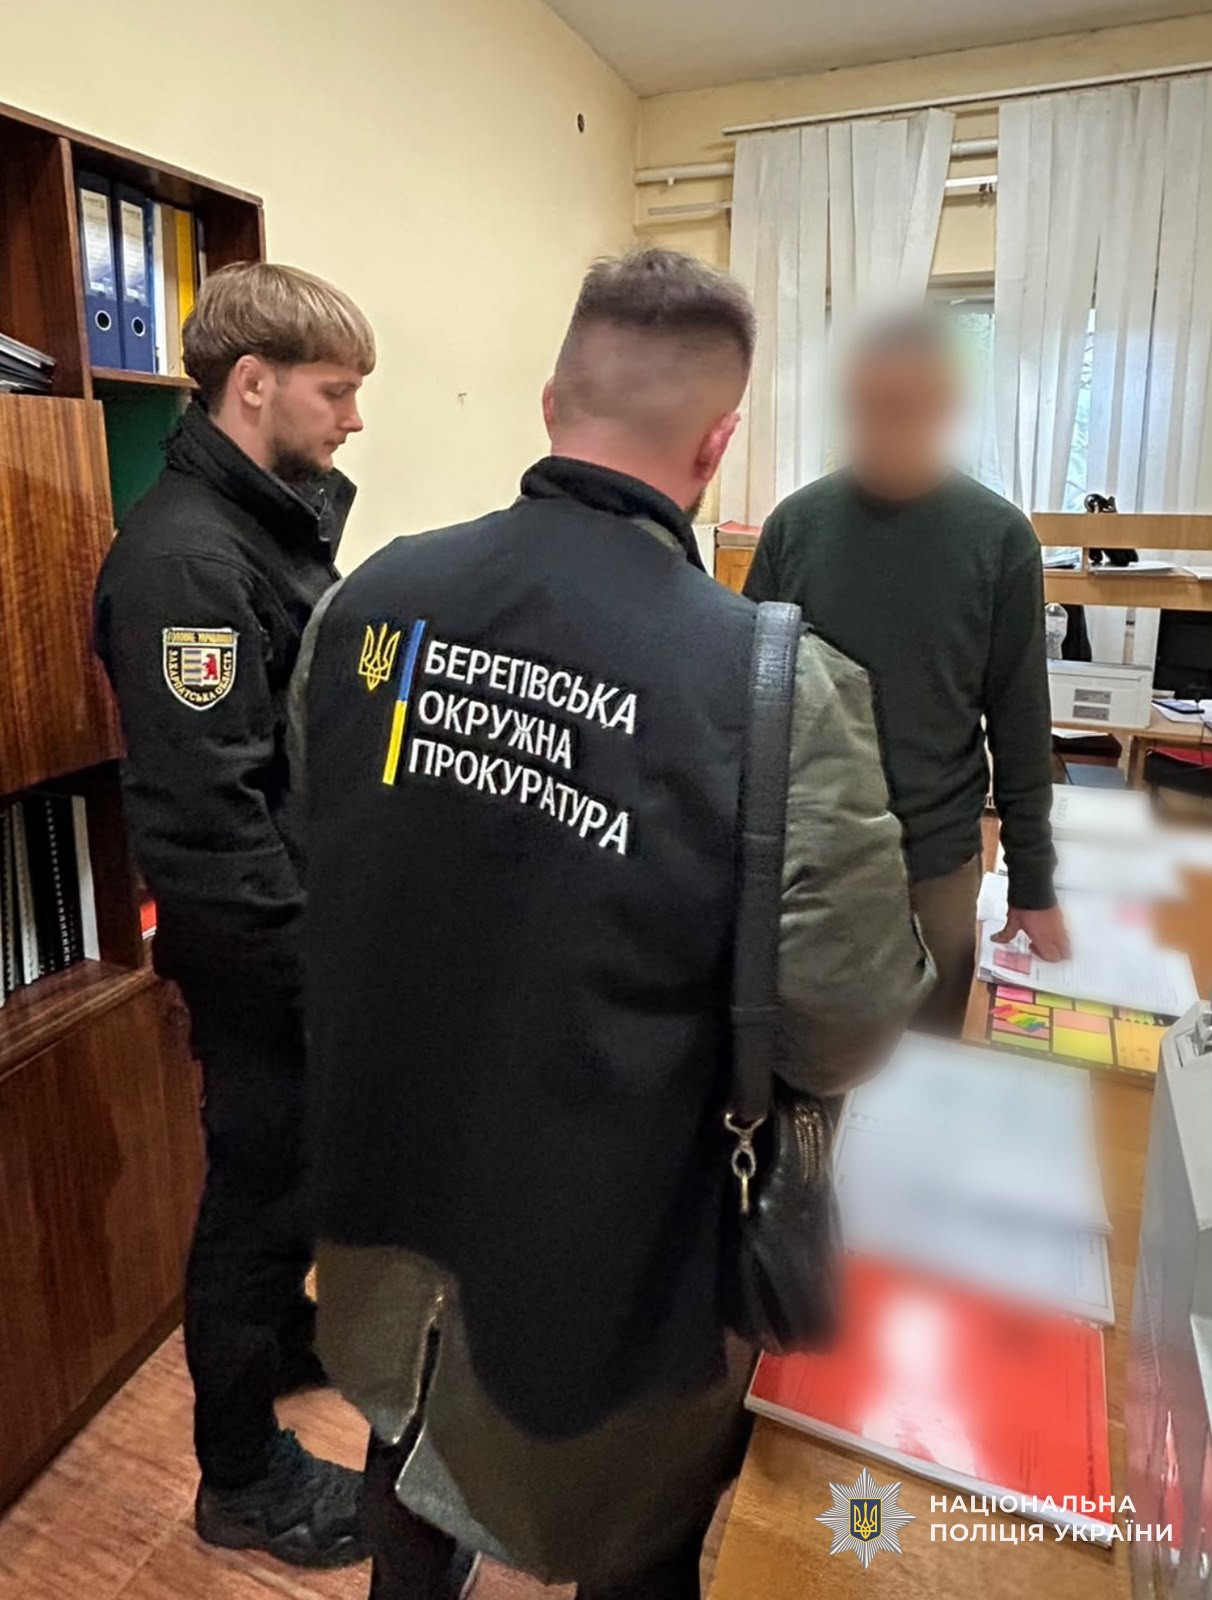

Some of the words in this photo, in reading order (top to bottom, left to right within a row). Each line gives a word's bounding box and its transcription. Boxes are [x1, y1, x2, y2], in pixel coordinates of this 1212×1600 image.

[418, 690, 572, 770] ОКРУЖНА
[424, 640, 638, 735] БЕРЕГІВСЬКА
[408, 738, 630, 856] ПРОКУРАТУРА
